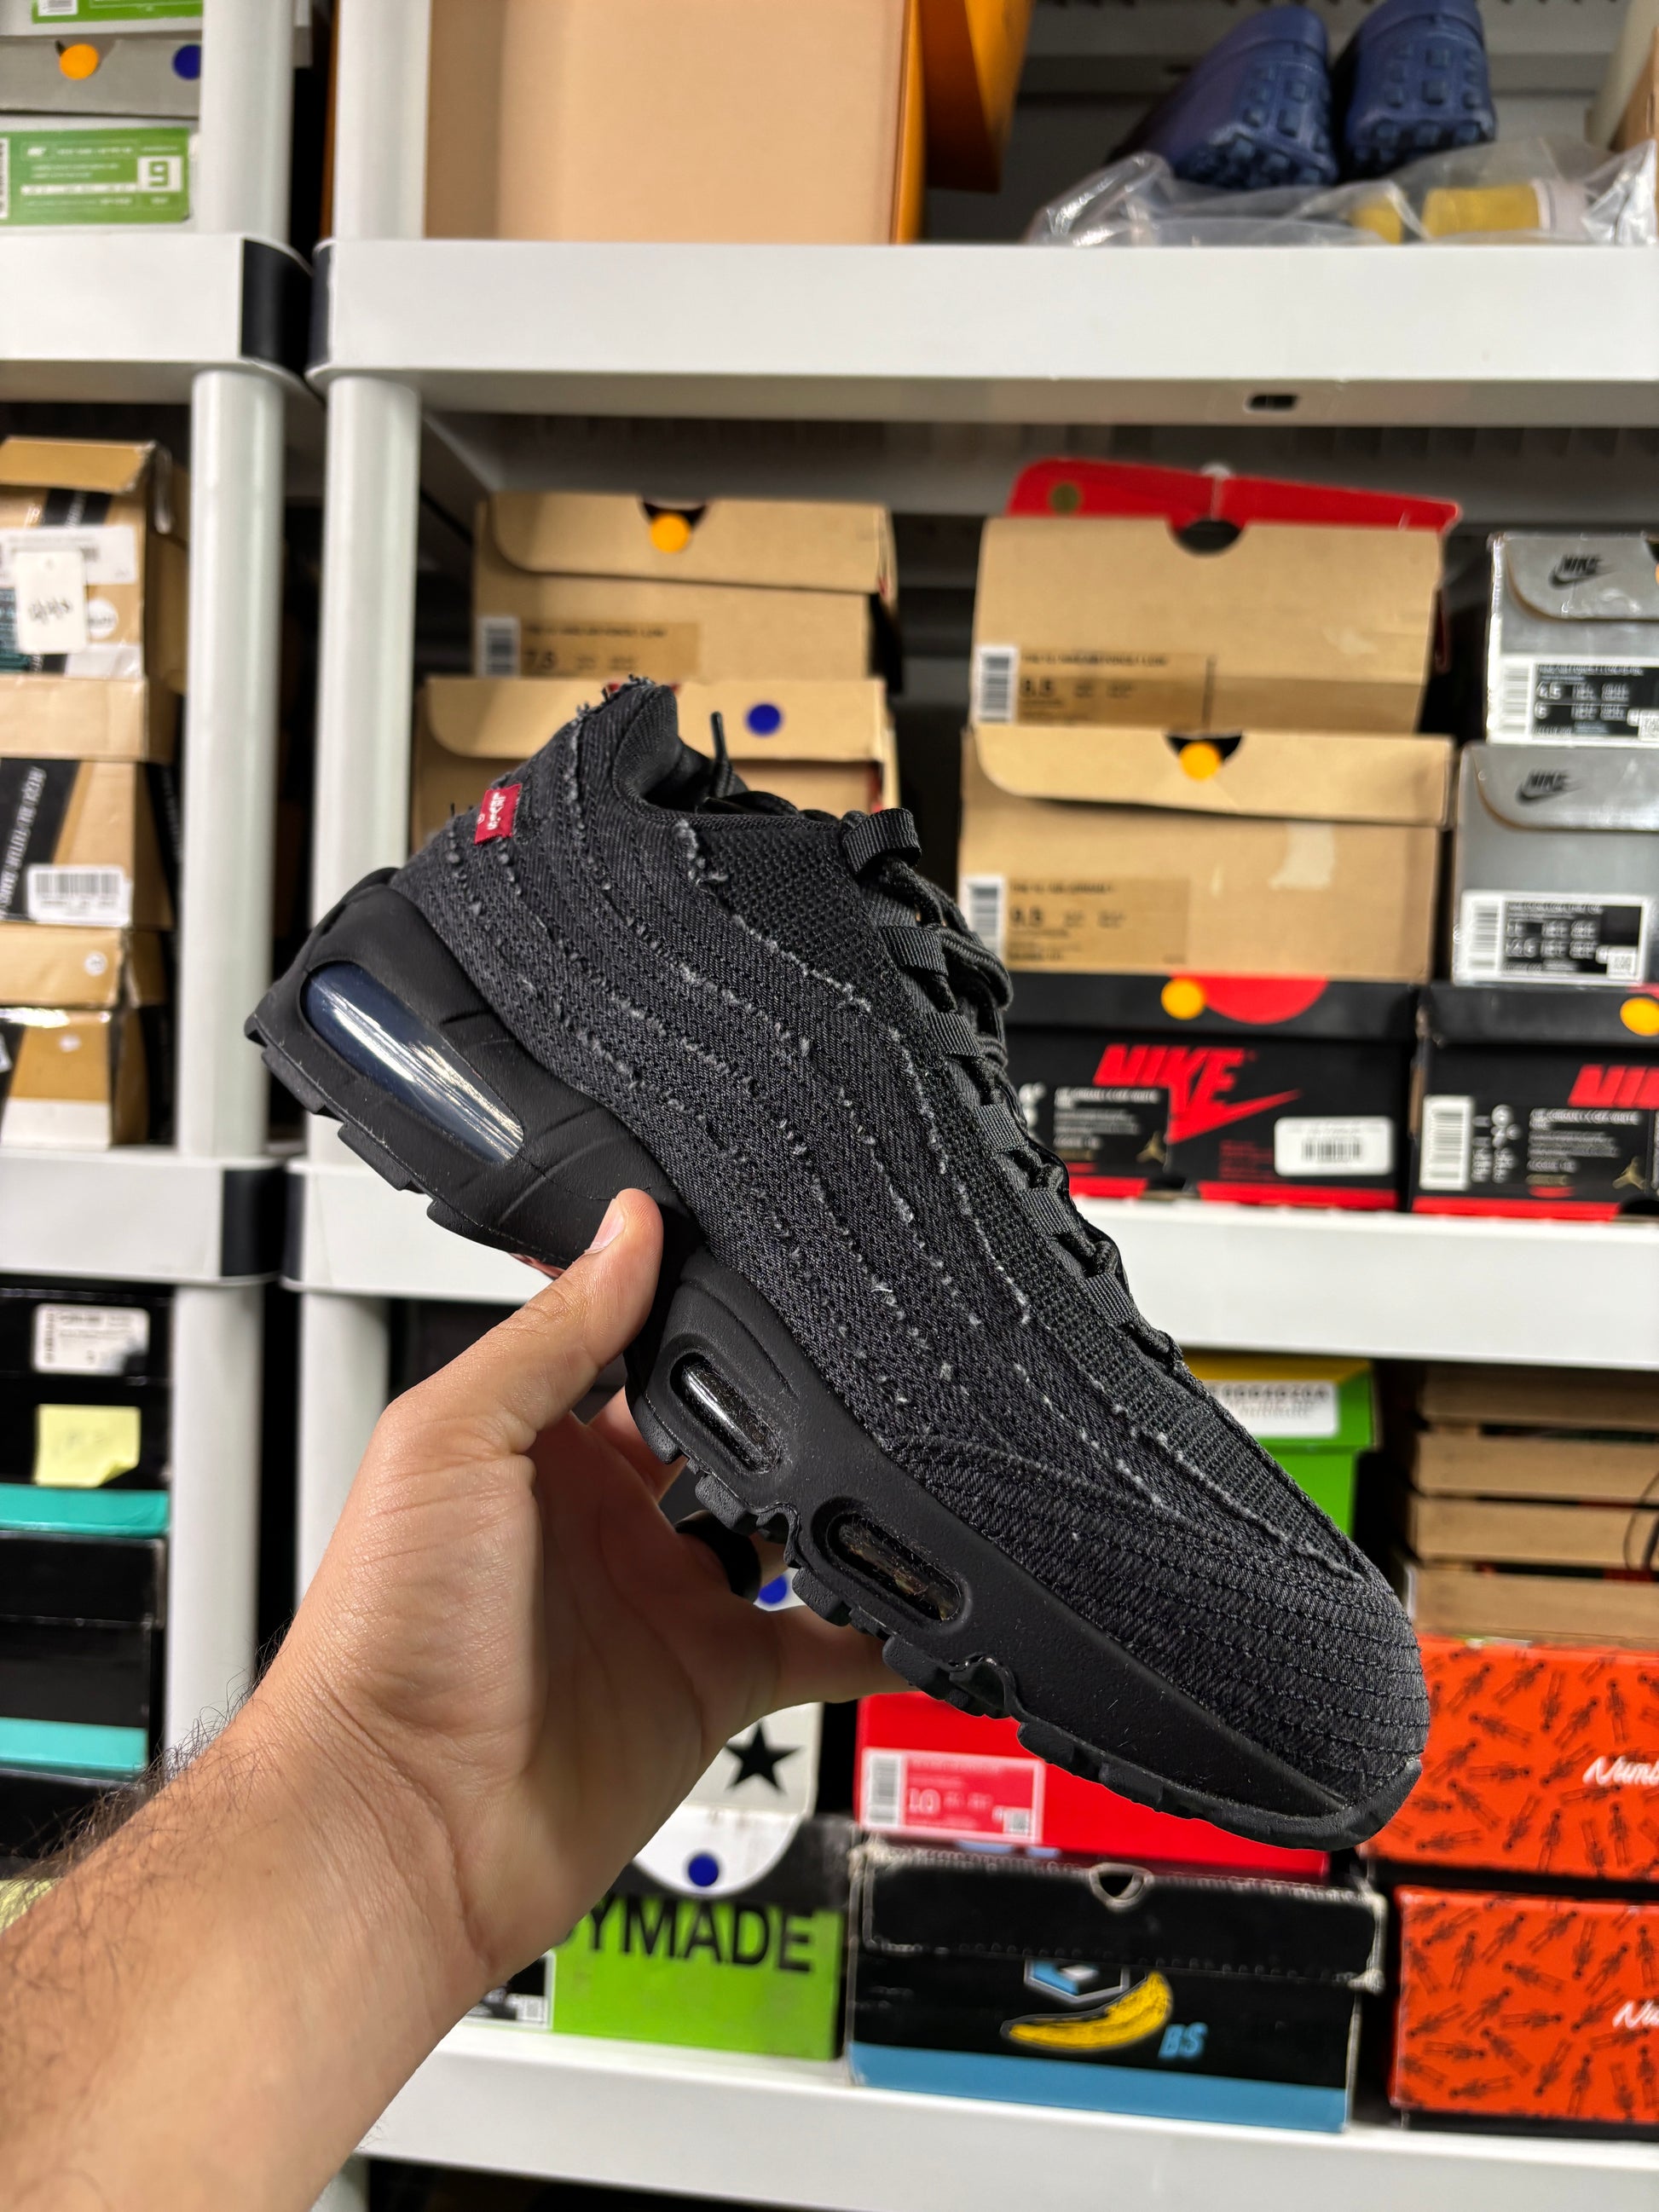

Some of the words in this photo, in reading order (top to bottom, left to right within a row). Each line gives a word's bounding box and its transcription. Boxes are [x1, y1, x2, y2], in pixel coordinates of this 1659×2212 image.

[148, 161, 169, 187] 9
[1092, 1043, 1246, 1110] NIKE
[560, 1894, 814, 1972] YMADE
